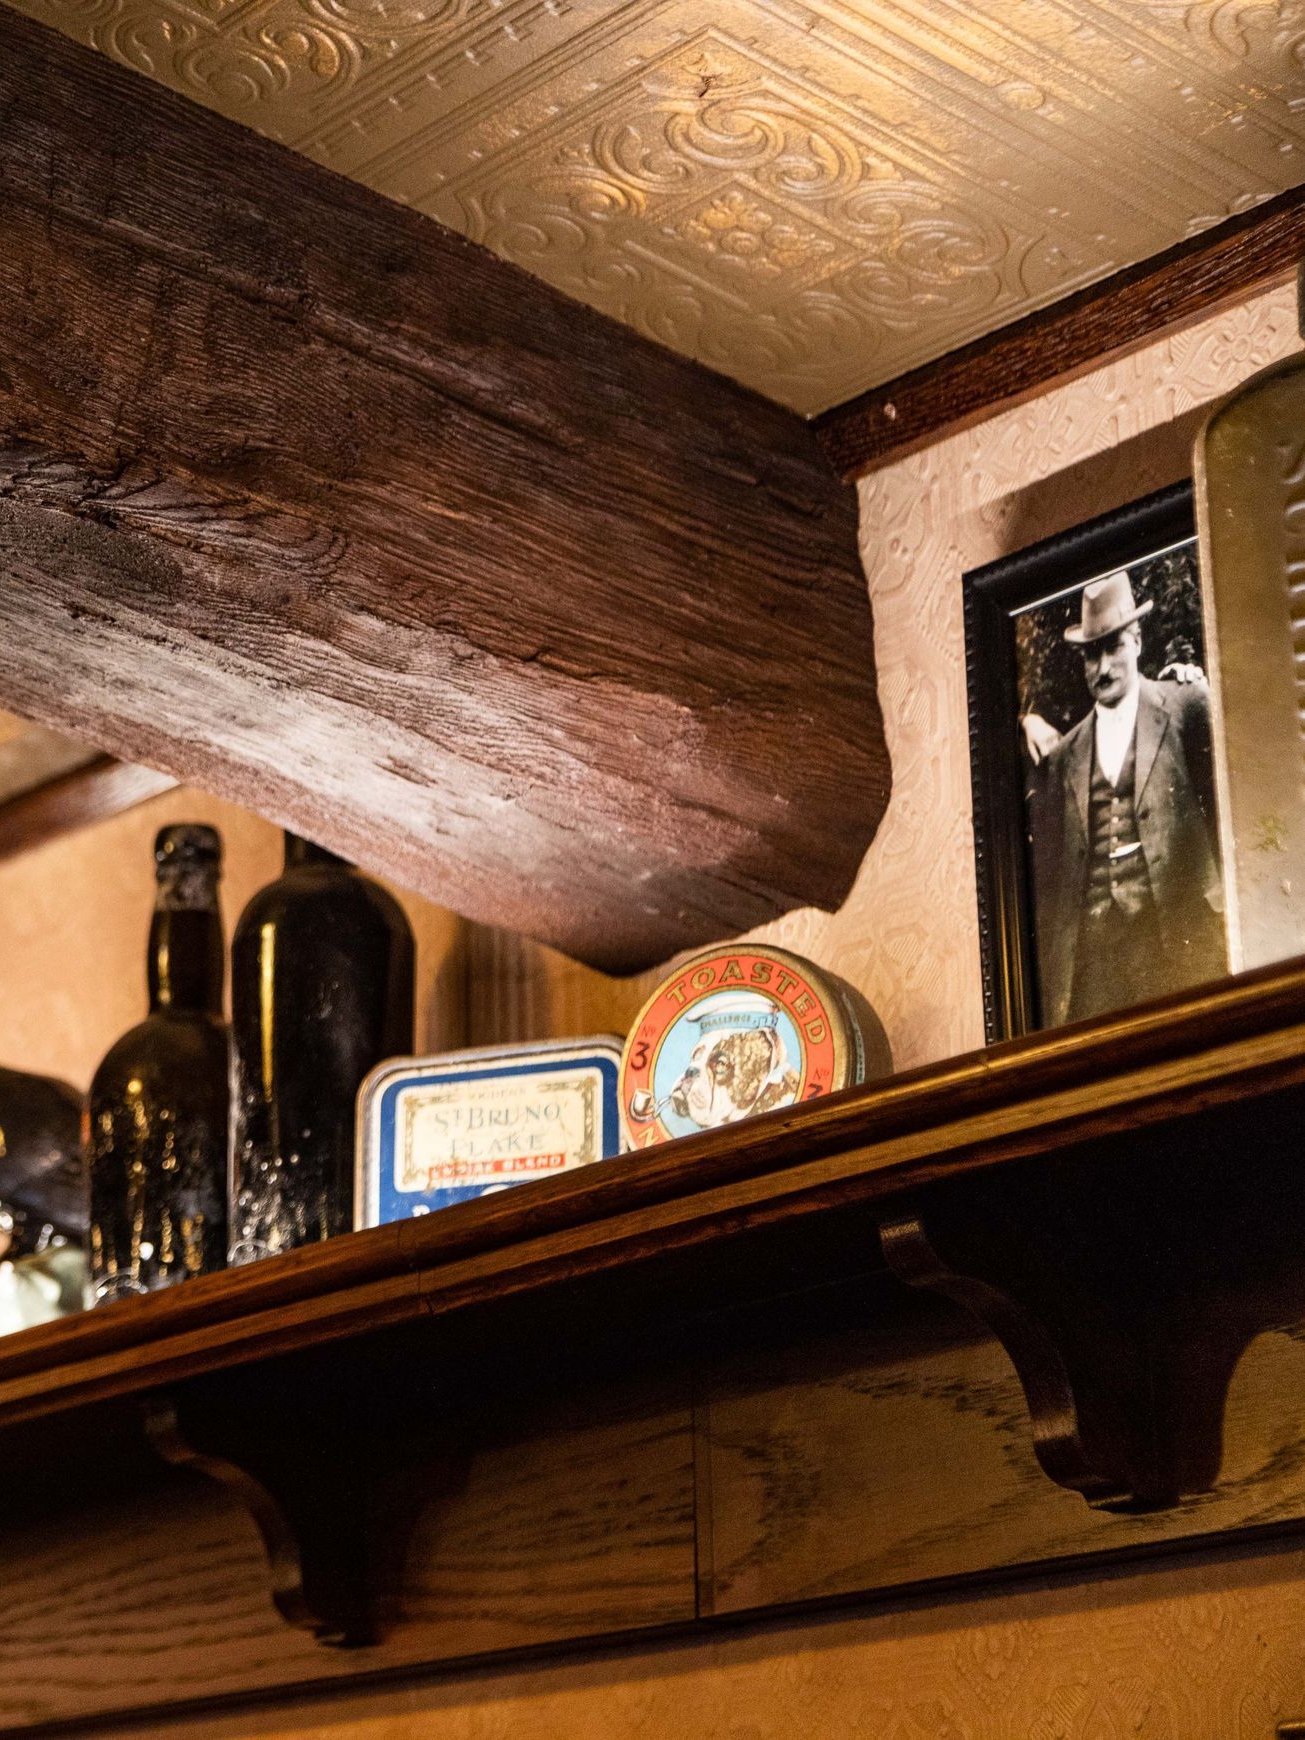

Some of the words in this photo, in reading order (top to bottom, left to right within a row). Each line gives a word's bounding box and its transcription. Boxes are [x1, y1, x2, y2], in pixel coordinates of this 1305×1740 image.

[666, 959, 827, 1044] TOASTED
[631, 1041, 650, 1071] 3
[468, 1103, 561, 1130] BRUNO
